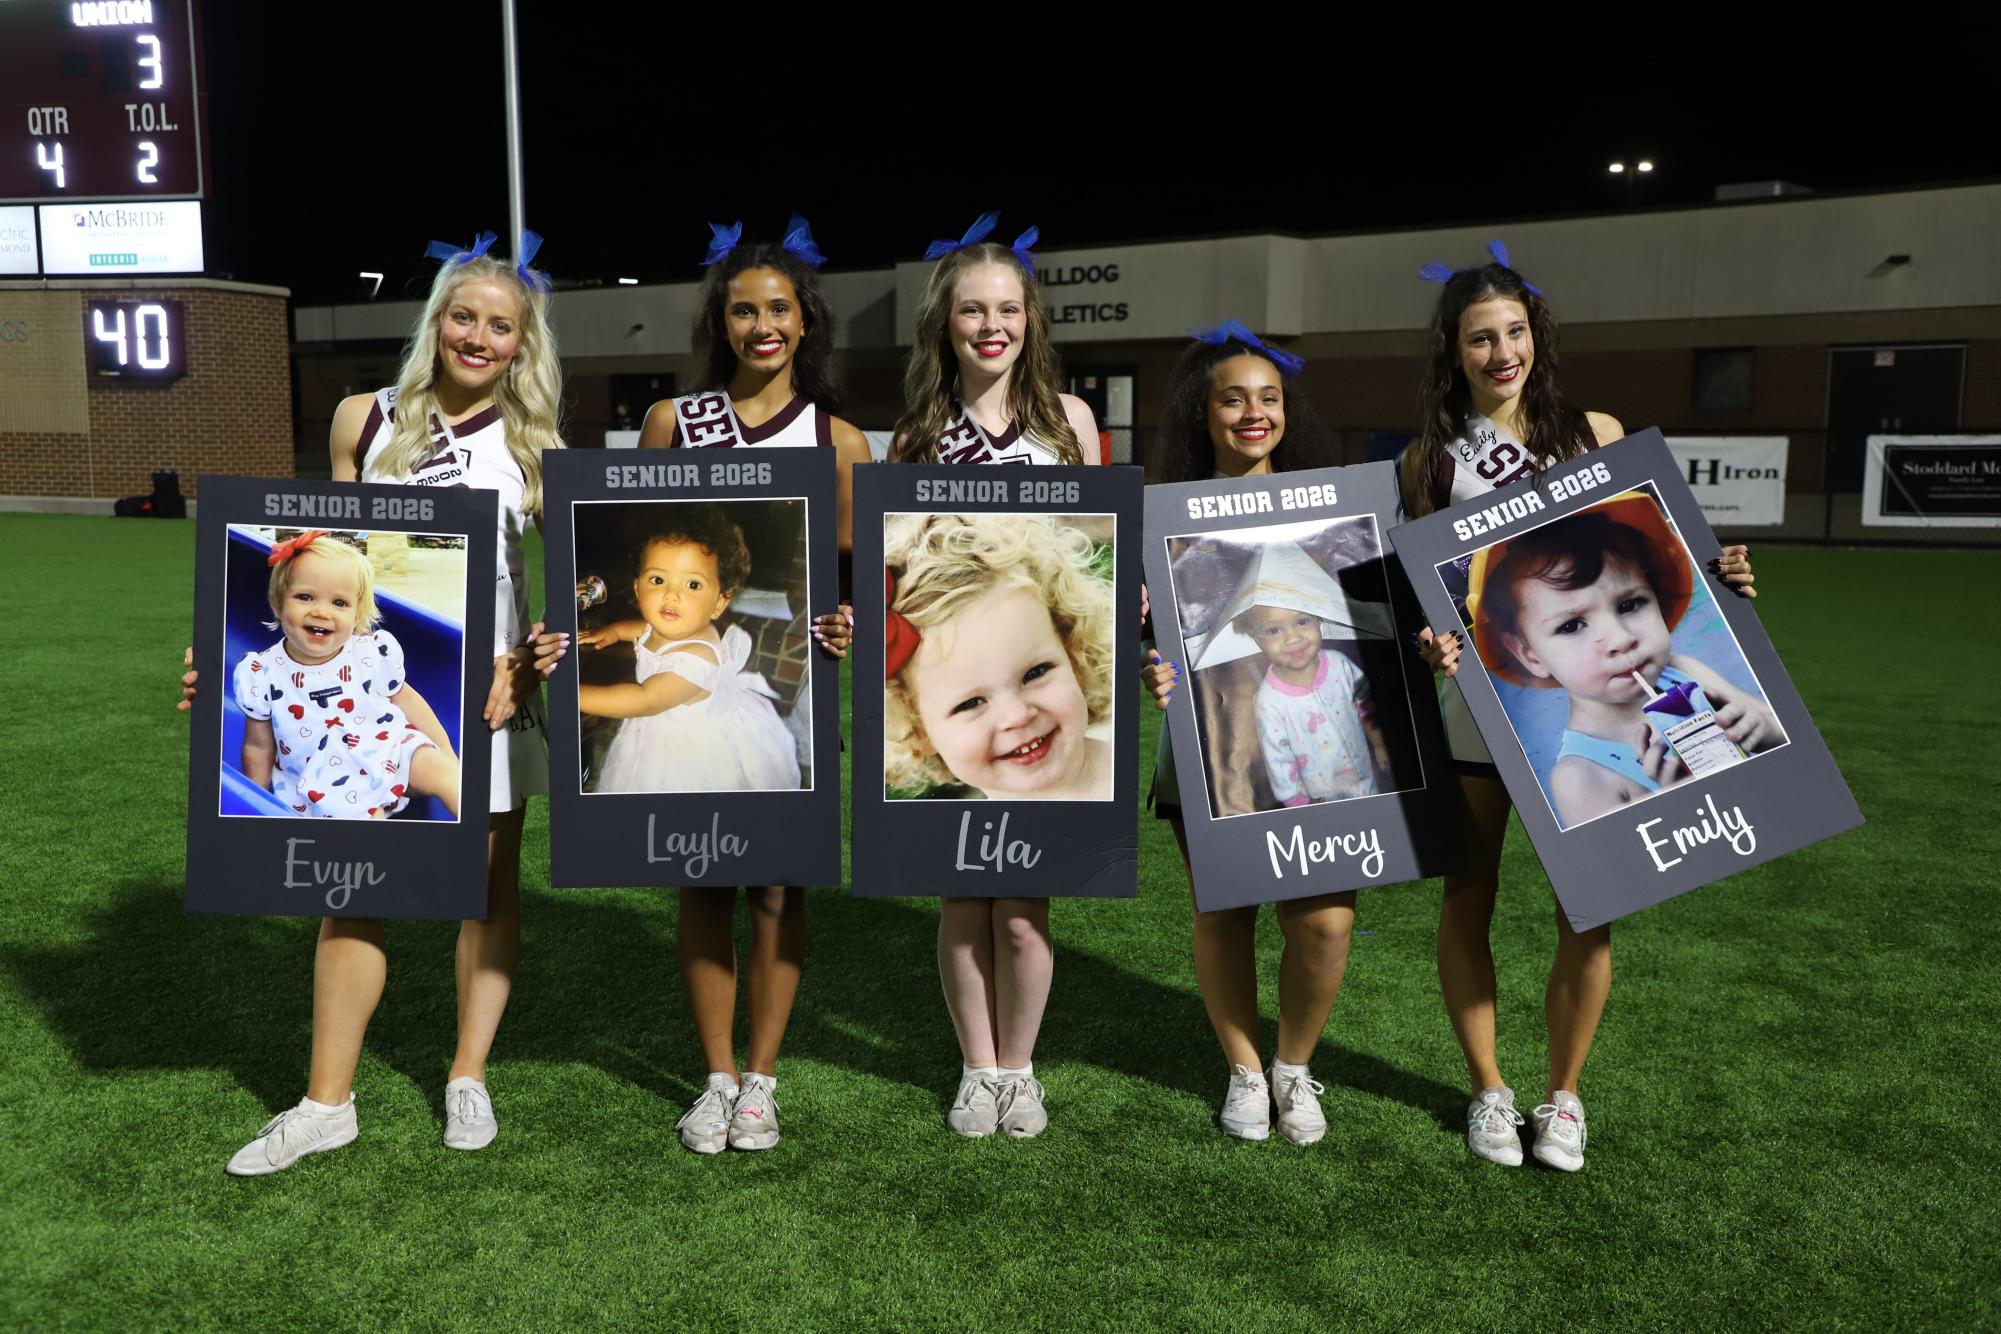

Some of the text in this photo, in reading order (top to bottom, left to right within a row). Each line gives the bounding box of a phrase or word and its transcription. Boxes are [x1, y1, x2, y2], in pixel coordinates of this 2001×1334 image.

[72, 0, 153, 26] UNION
[136, 35, 163, 89] 3
[28, 107, 69, 135] QTR
[125, 103, 178, 131] T.O.L.
[37, 142, 65, 188] 4
[137, 142, 158, 183] 2
[1037, 264, 1120, 287] LLDOG
[1049, 303, 1129, 324] LETICS
[94, 305, 169, 369] 40
[606, 462, 772, 488] SENIOR 2026
[1902, 461, 1977, 474] Stoddard
[265, 494, 434, 521] SENIOR 2026
[916, 480, 1080, 503] SENIOR 2026
[1187, 484, 1337, 519] SENIOR 2026
[1453, 462, 1611, 541] SENIOR 2026
[1666, 712, 1712, 737] Nutrition Facts
[646, 812, 749, 879] Layla
[956, 810, 1041, 872] Lila
[1636, 793, 1756, 872] Emily
[1266, 825, 1385, 879] Mercy
[284, 837, 386, 909] Evyn
